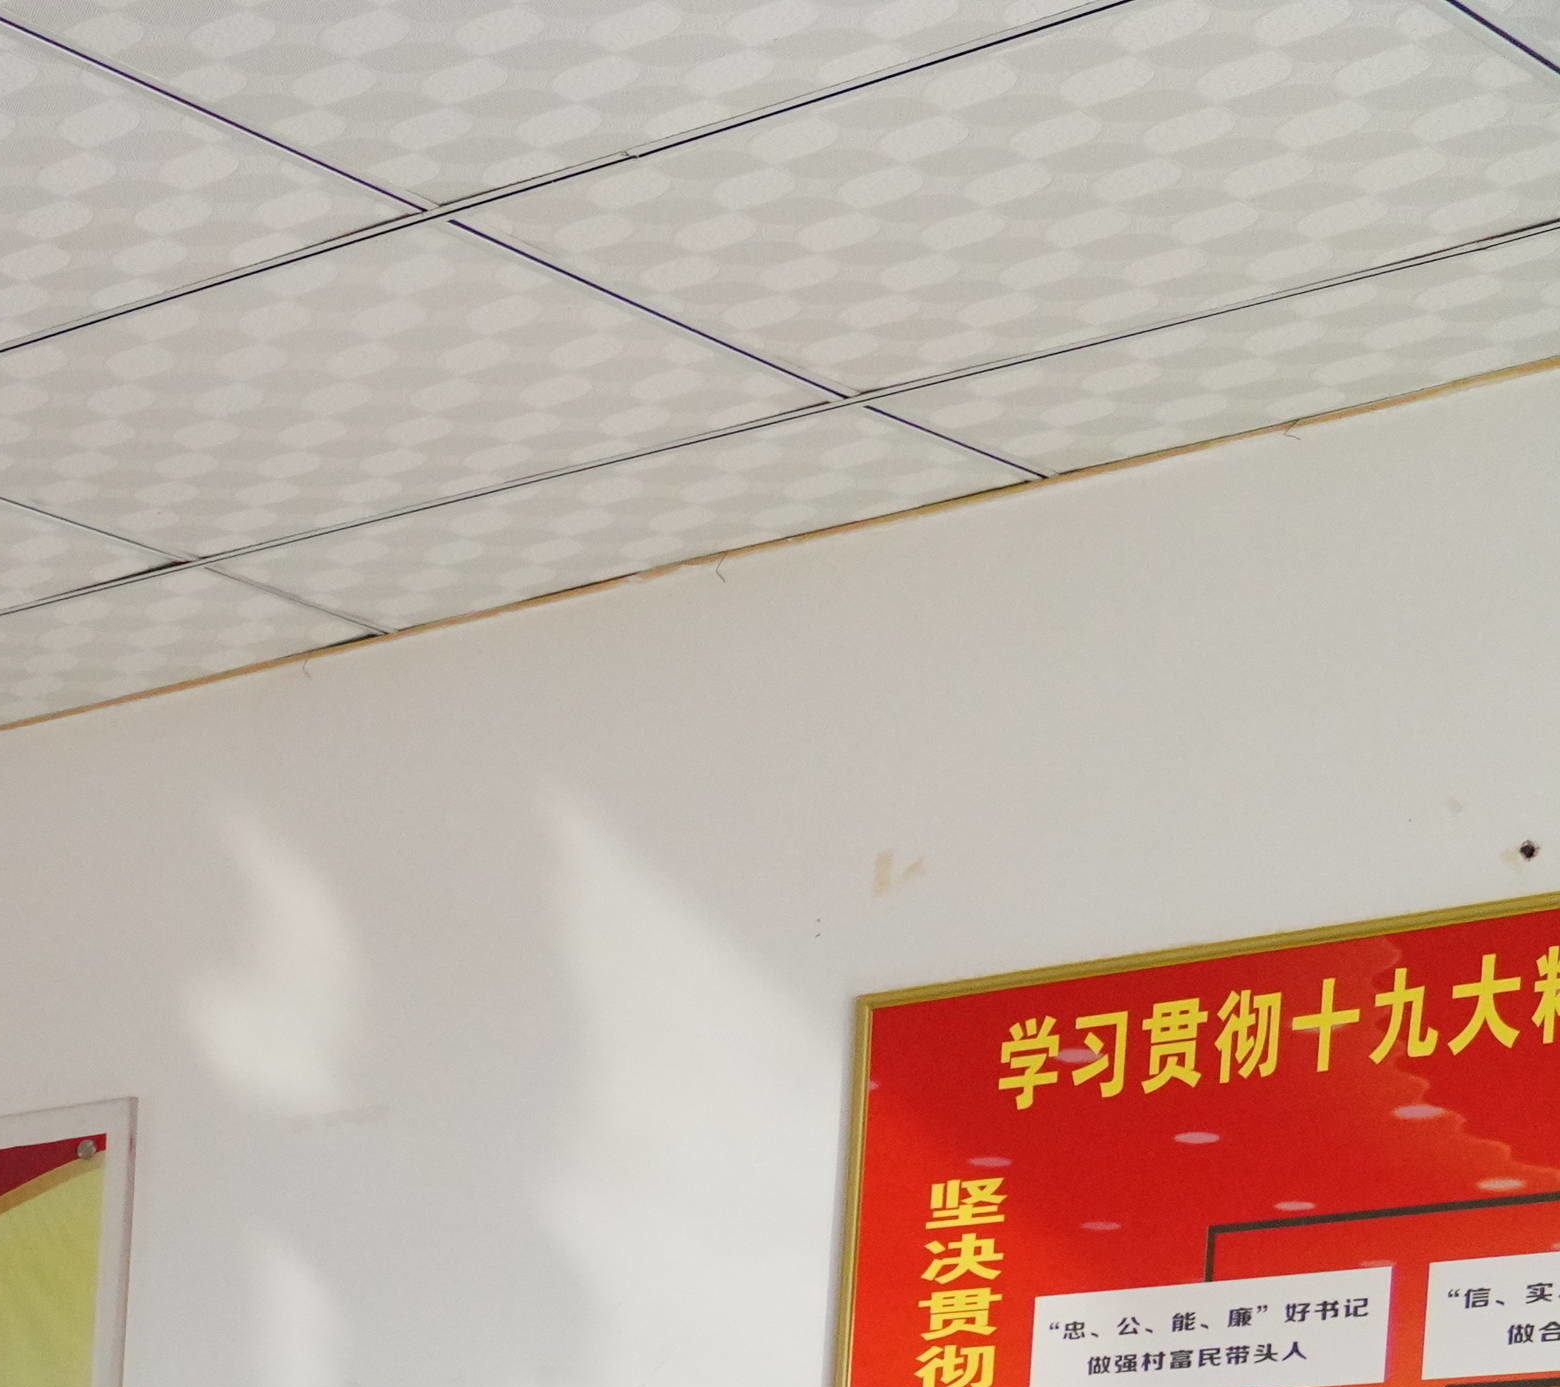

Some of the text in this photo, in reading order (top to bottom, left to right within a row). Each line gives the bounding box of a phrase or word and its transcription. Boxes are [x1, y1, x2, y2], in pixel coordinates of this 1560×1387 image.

[1446, 1281, 1560, 1311] “信、实
[1048, 1296, 1370, 1342] “忠、公、能、廉”好书记
[1087, 1340, 1308, 1376] 做强村富民带头人
